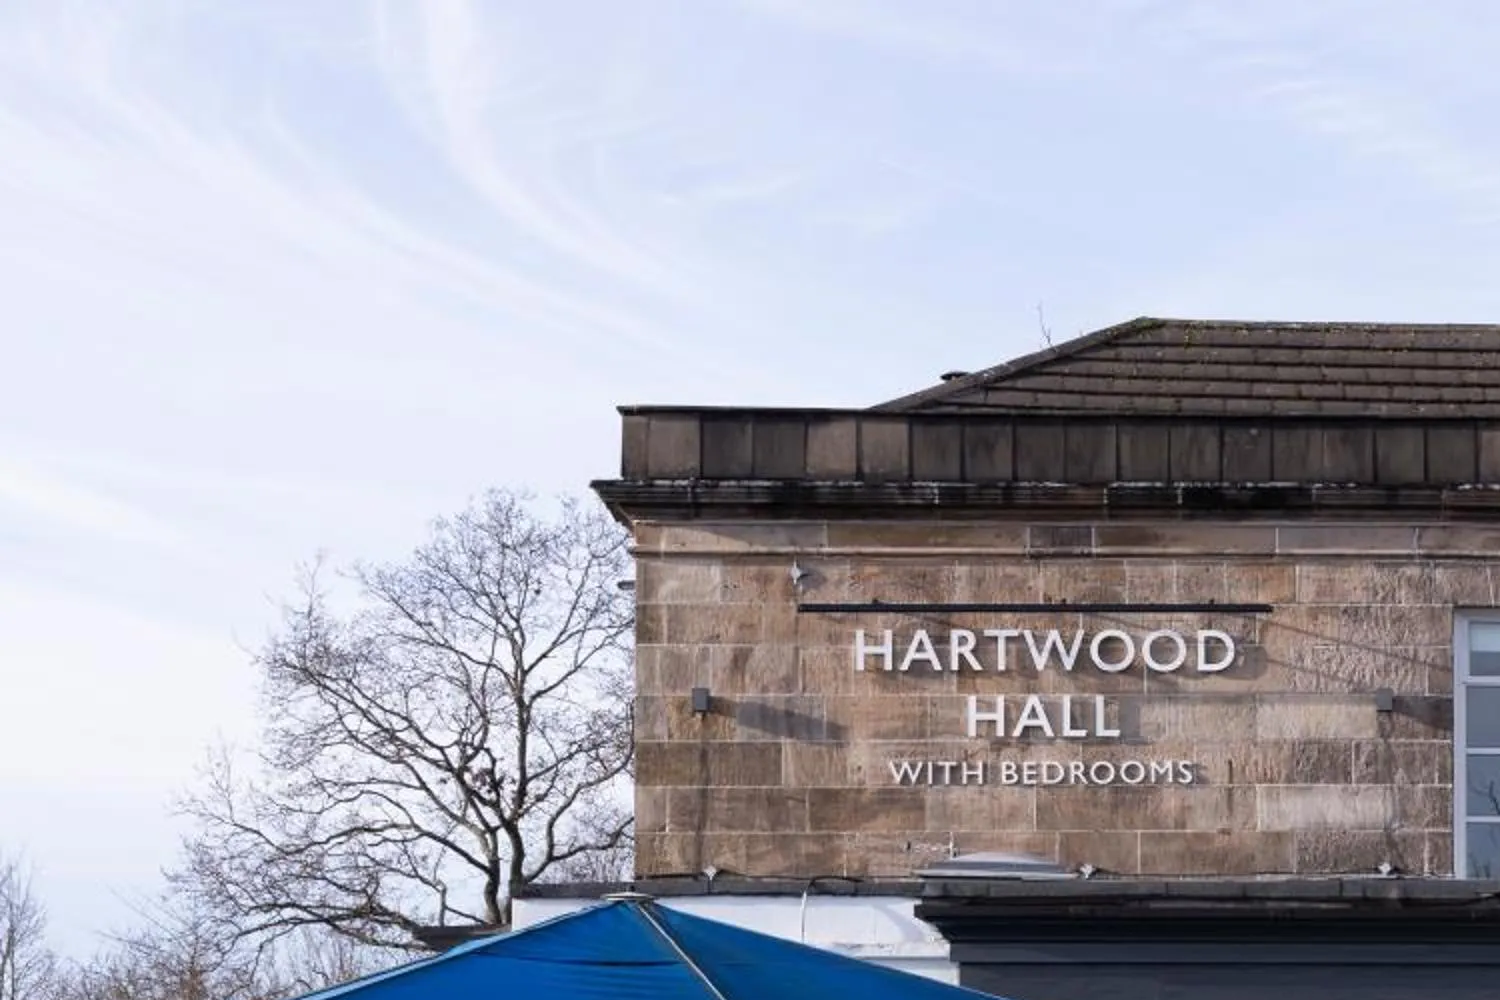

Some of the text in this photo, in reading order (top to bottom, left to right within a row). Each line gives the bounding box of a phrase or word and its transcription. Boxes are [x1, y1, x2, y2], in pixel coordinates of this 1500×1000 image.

[855, 629, 1235, 672] HARTWOOD
[966, 694, 1121, 738] HALL
[888, 760, 1194, 785] WITH BEDROOMS
